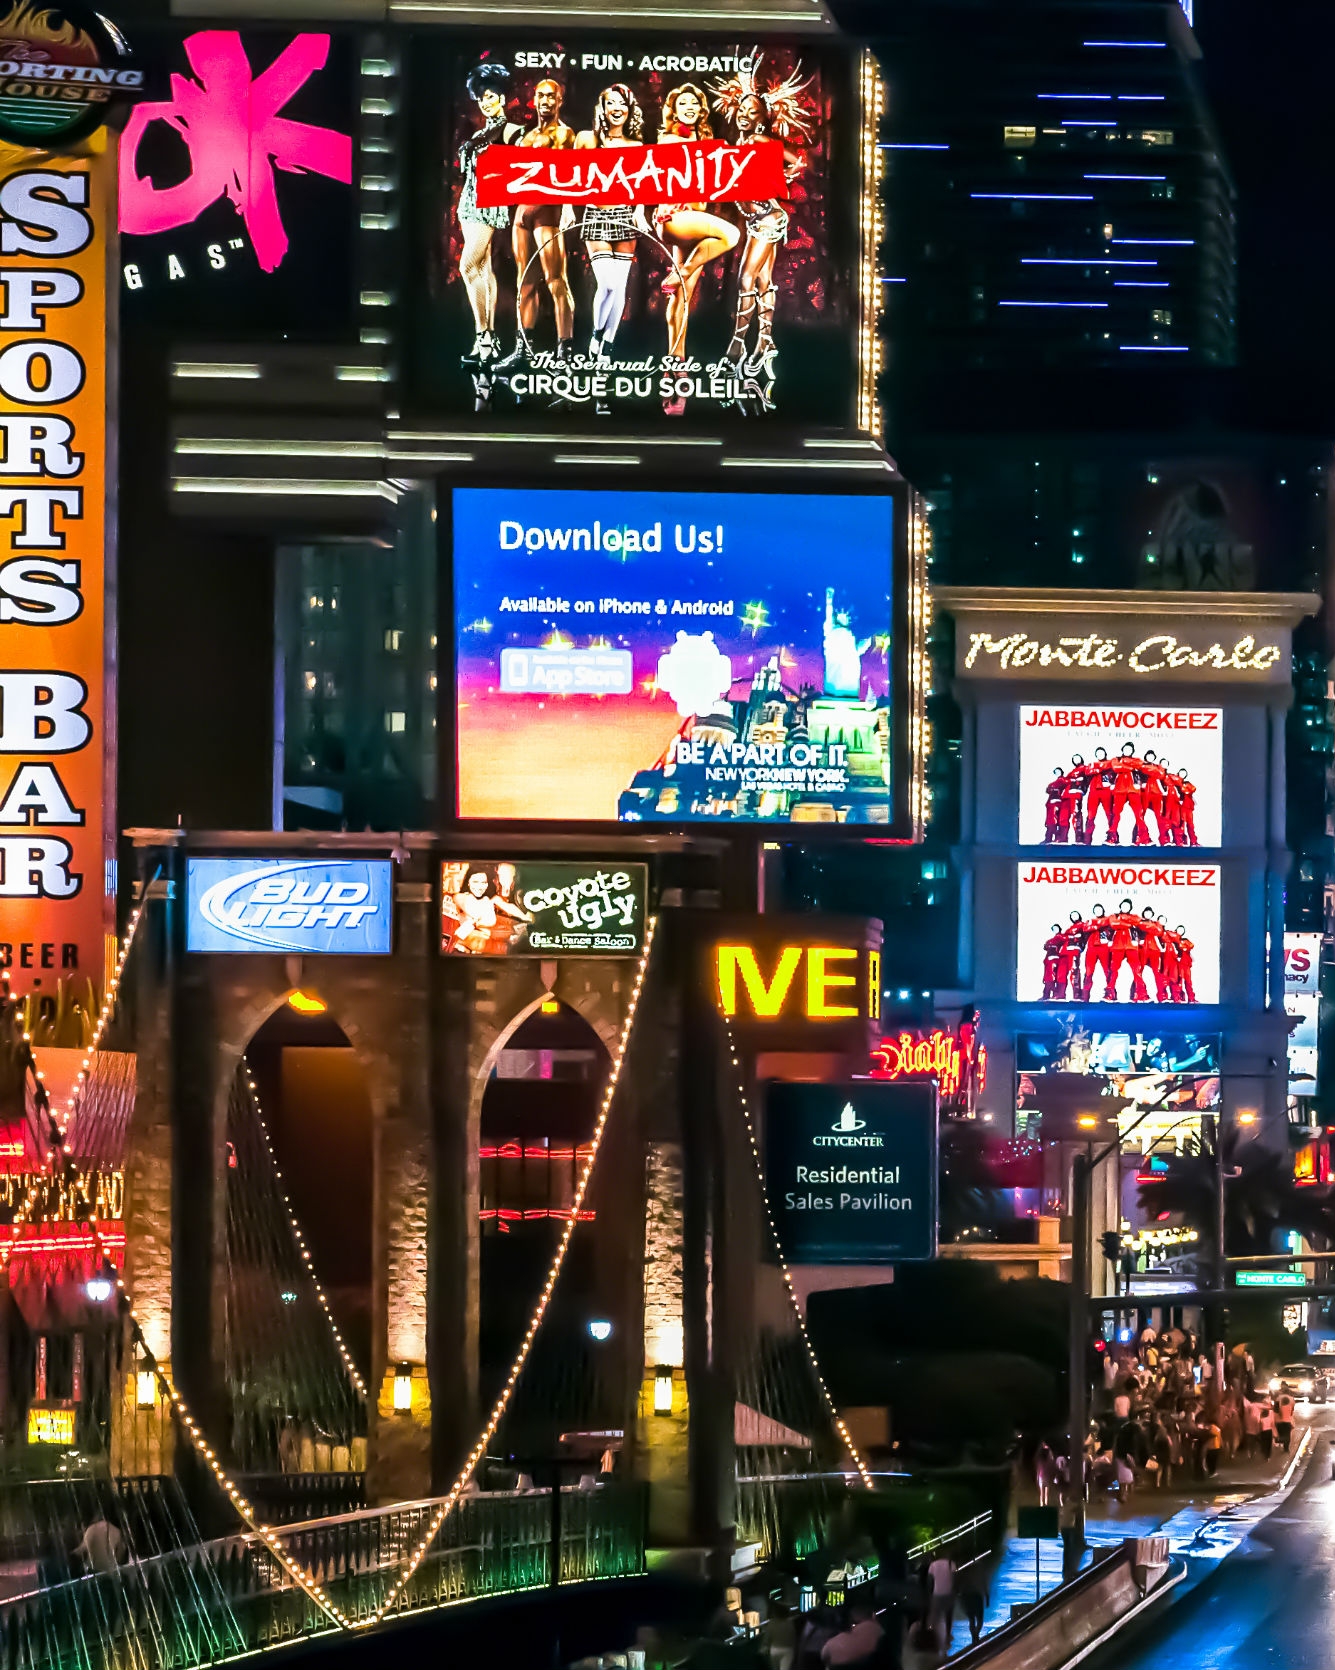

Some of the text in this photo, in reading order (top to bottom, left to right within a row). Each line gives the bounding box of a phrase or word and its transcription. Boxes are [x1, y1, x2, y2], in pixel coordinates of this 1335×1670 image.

[514, 52, 754, 73] SEXY FUN ACROBATIC
[0, 82, 112, 102] OUSE
[506, 144, 757, 200] ZUMANITY
[531, 354, 729, 377] The Sensual Side of
[0, 171, 91, 624] SPORTS
[510, 374, 749, 401] CIRQUE DU SOLEIL
[499, 521, 724, 555] Download Us!
[499, 597, 734, 616] Available on iPhone & Android
[964, 632, 1281, 673] Monte Carlo
[532, 666, 573, 690] App
[1025, 710, 1218, 730] JABBAWOCKEEZ
[677, 743, 704, 764] BE
[710, 744, 729, 765] A
[731, 743, 786, 766] PART
[790, 744, 823, 767] OF
[0, 671, 92, 898] BAR
[1023, 867, 1216, 886] JABBAWOCKEEZ
[249, 880, 370, 904] BUD
[230, 905, 378, 929] LIGHT
[562, 936, 592, 945] Dance
[813, 1134, 885, 1148] CITYCENTER
[796, 1165, 901, 1185] Residential
[785, 1191, 913, 1211] Sales Pavilion
[1246, 1274, 1275, 1283] MONTE
[1276, 1275, 1305, 1284] CARLO
